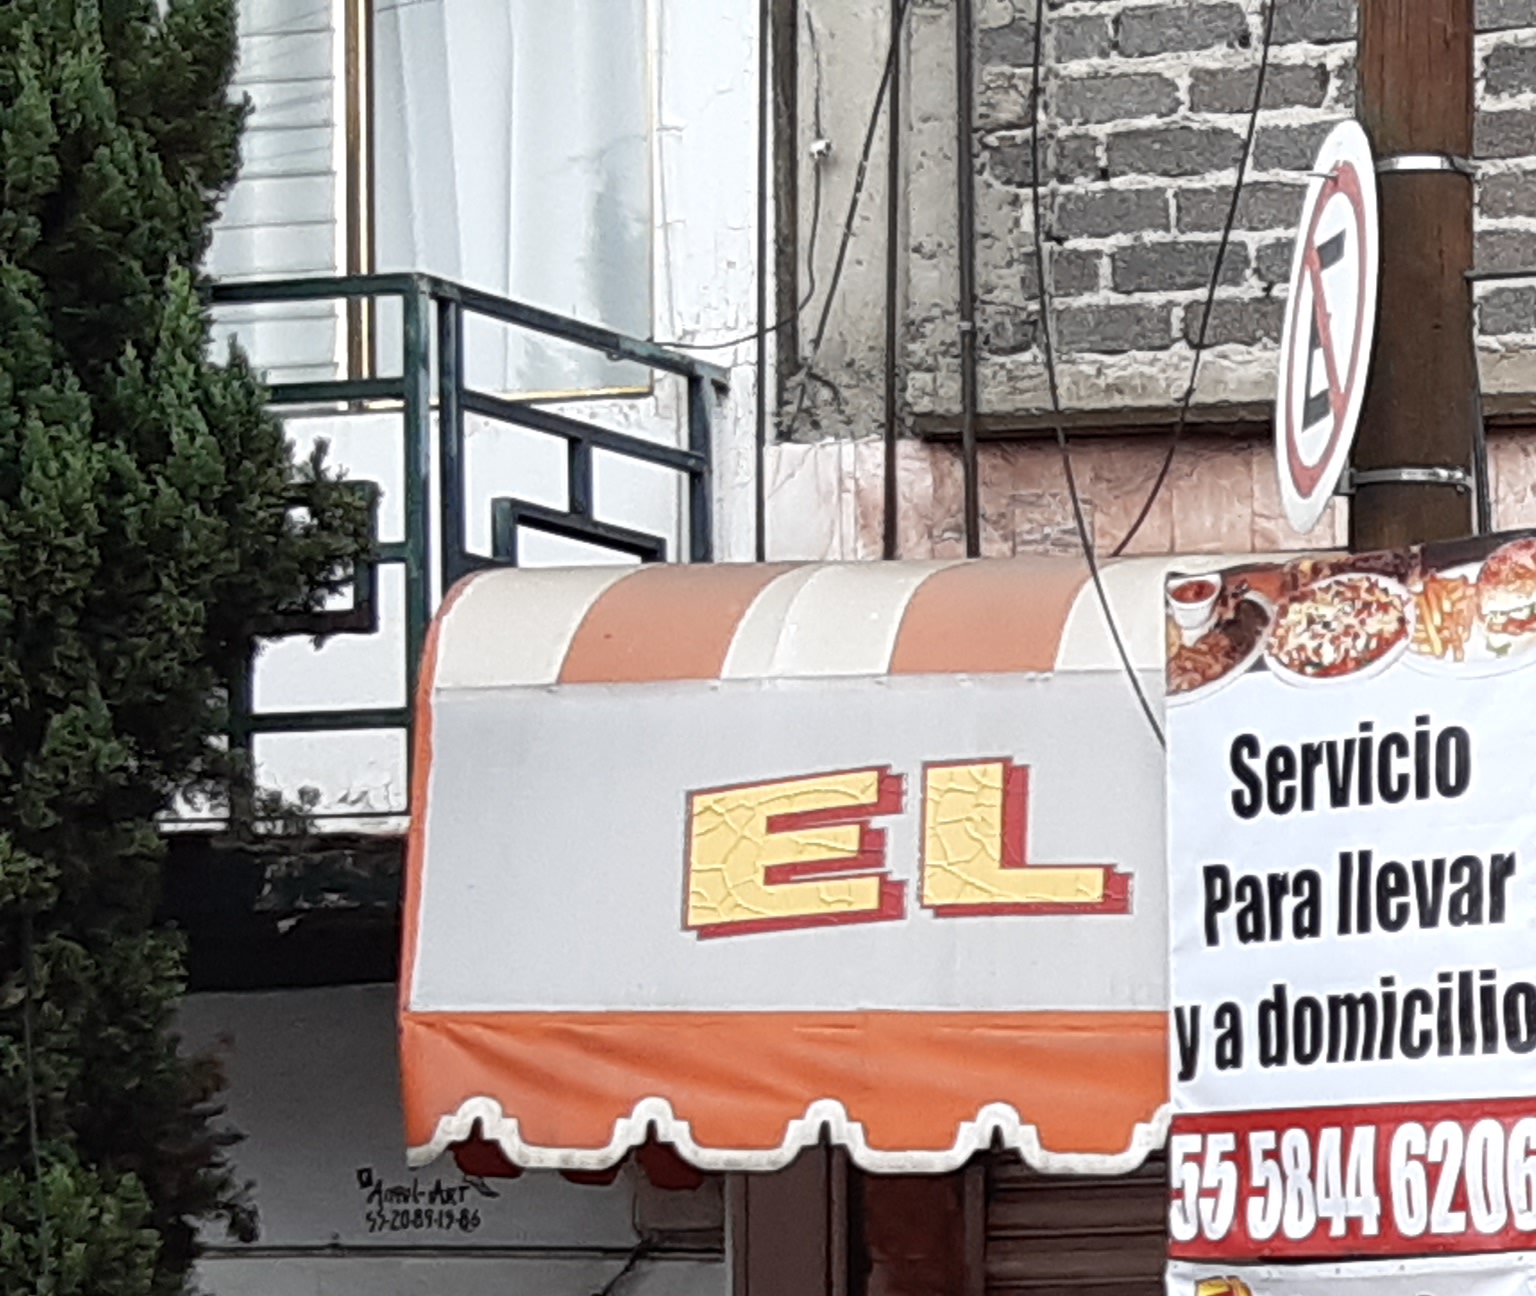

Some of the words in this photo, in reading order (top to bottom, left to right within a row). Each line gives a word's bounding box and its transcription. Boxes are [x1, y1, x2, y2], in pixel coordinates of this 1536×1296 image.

[1230, 715, 1470, 820] Servicio
[681, 756, 1133, 941] EL
[1203, 864, 1322, 947] Para
[1337, 850, 1516, 935] llevar
[1175, 1005, 1200, 1082] y
[1214, 1002, 1242, 1070] a
[1170, 1132, 1237, 1242] 55
[1247, 1124, 1380, 1239] 5844
